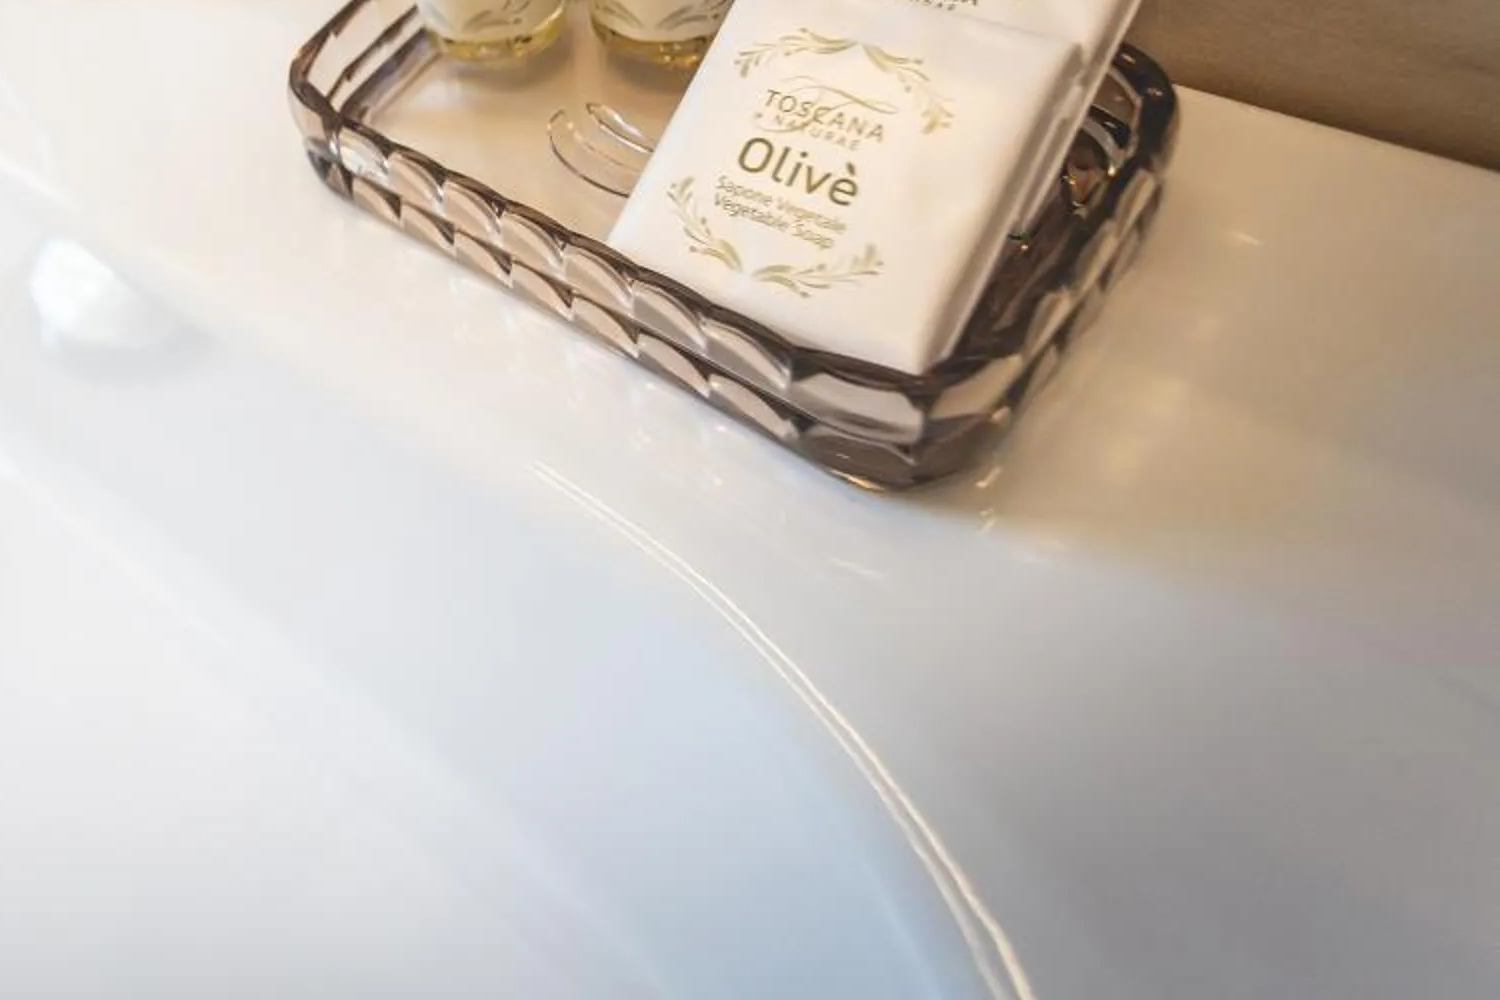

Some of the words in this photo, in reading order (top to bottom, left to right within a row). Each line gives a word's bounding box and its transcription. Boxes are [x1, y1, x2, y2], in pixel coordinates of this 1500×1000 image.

[766, 90, 883, 141] TOSCANA
[738, 138, 858, 206] Olivè
[714, 193, 789, 230] Vegetable
[792, 219, 835, 250] Soap
